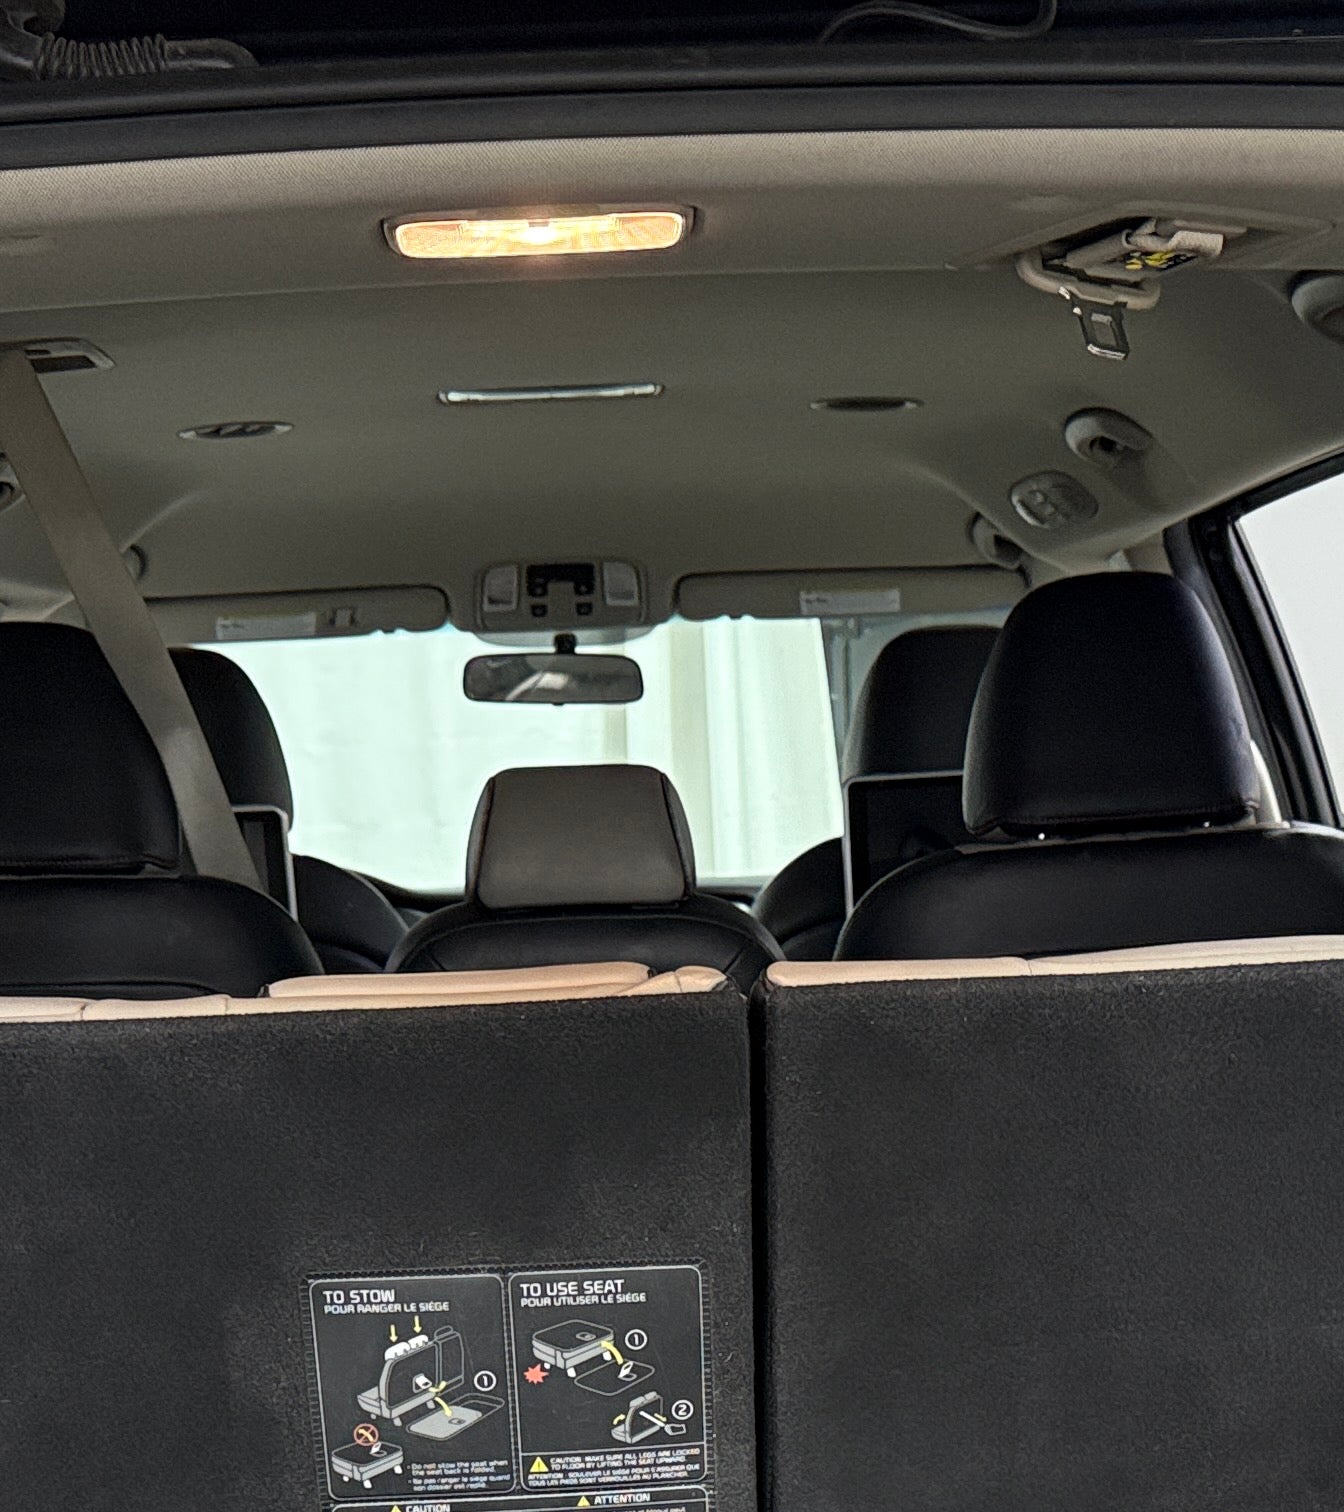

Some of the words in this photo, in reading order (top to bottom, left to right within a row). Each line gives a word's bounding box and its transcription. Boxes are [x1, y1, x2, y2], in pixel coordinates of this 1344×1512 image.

[520, 1283, 543, 1297] TO
[547, 1282, 578, 1296] USE
[583, 1279, 625, 1295] SEAT
[323, 1290, 346, 1304] TO
[349, 1289, 395, 1303] STOW
[520, 1297, 552, 1307] POUR
[553, 1295, 599, 1306] UTILISER
[602, 1294, 615, 1304] LE
[323, 1304, 355, 1315] POUR
[357, 1303, 402, 1313] RANGER
[404, 1302, 416, 1313] LE
[594, 1493, 650, 1505] ATTENTION
